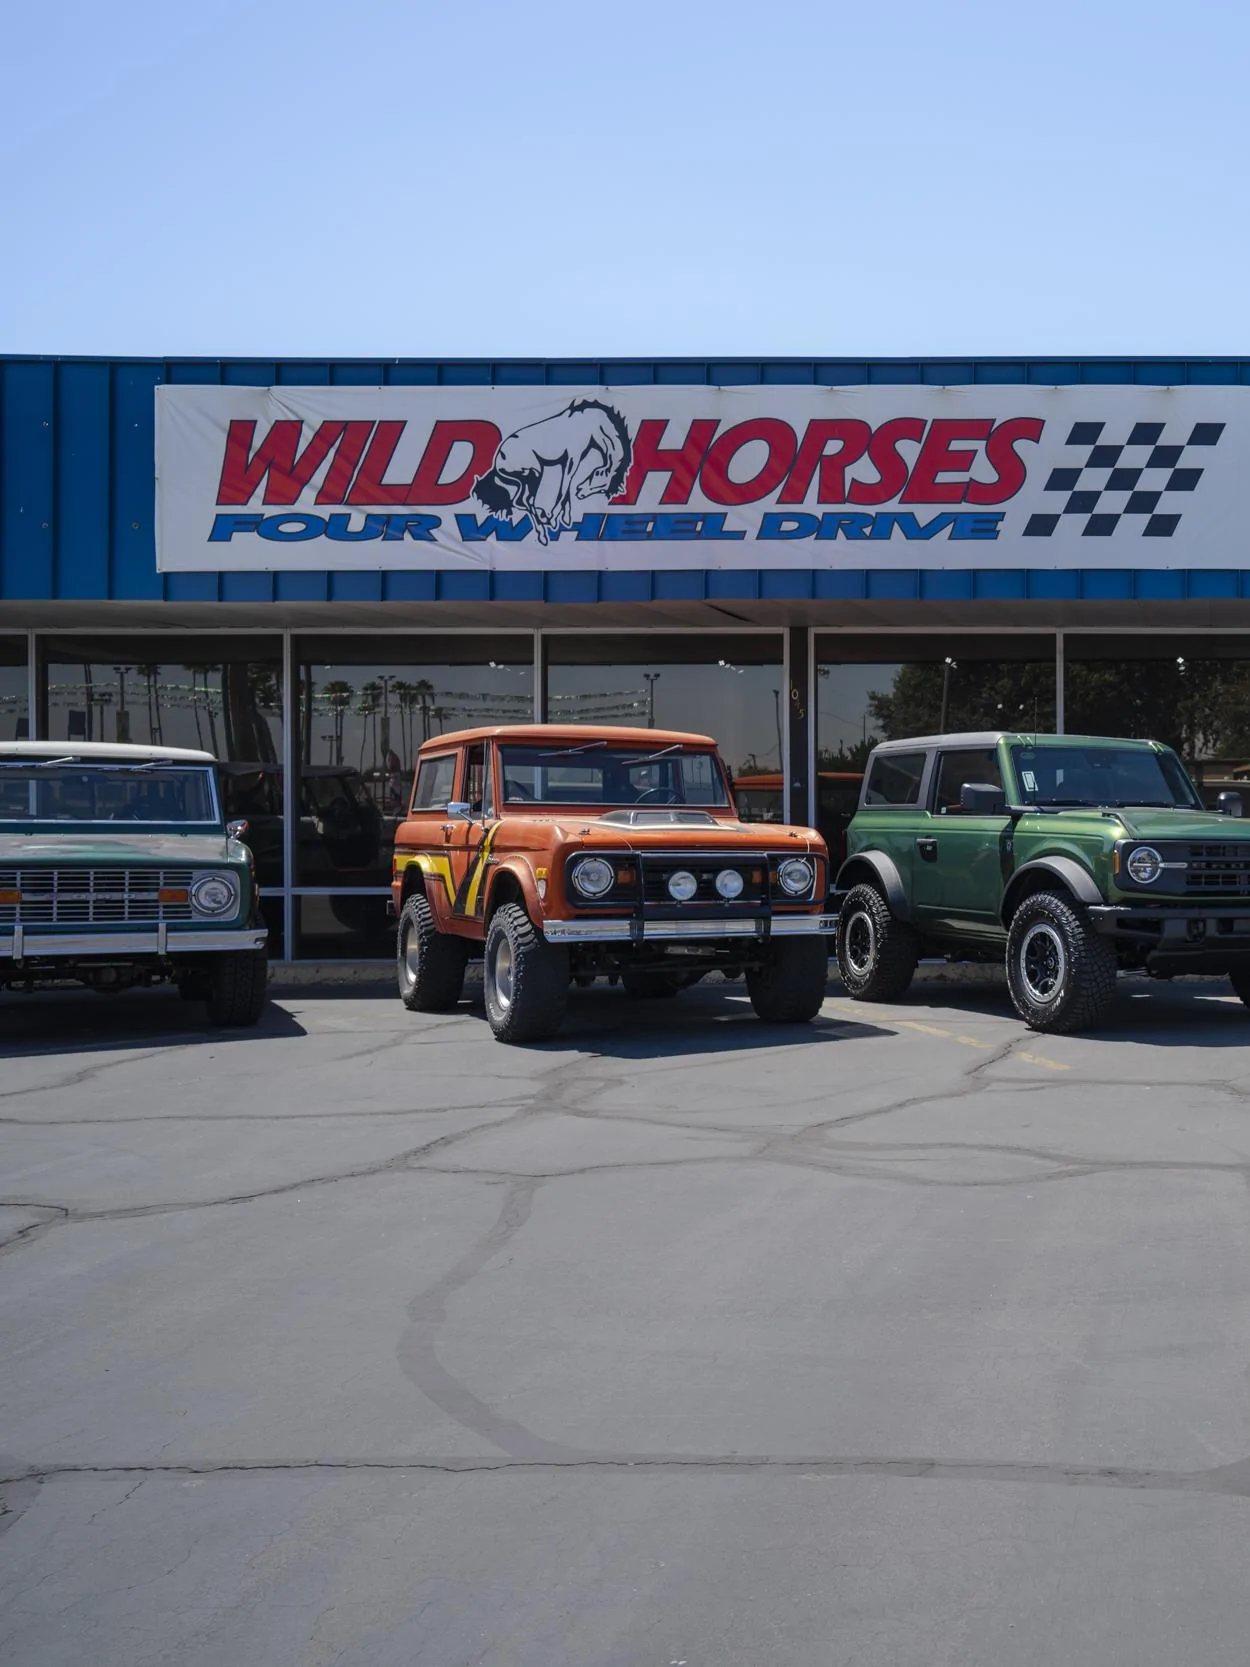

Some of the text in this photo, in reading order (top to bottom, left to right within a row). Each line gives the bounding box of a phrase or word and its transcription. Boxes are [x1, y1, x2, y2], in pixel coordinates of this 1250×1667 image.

[215, 417, 1045, 506] WILD HORSES
[207, 511, 1006, 543] FOUR WHEEL DRIVE
